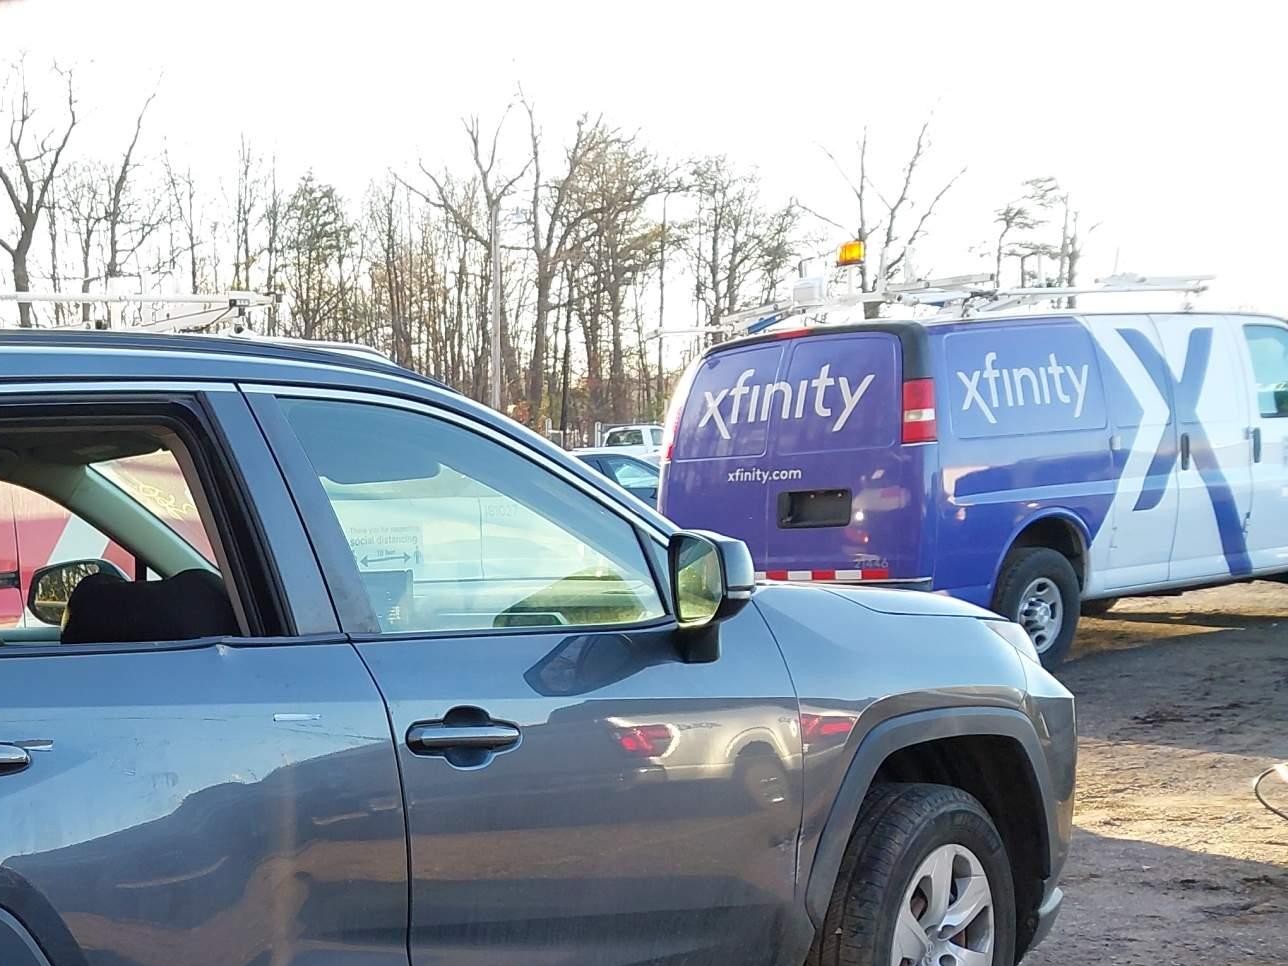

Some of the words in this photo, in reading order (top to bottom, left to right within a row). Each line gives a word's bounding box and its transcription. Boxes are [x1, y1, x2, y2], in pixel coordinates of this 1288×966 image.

[697, 363, 876, 440] xfinity
[956, 351, 1090, 424] xfinity
[727, 466, 802, 484] xfinity.com
[350, 536, 375, 546] social
[376, 535, 418, 545] distancing
